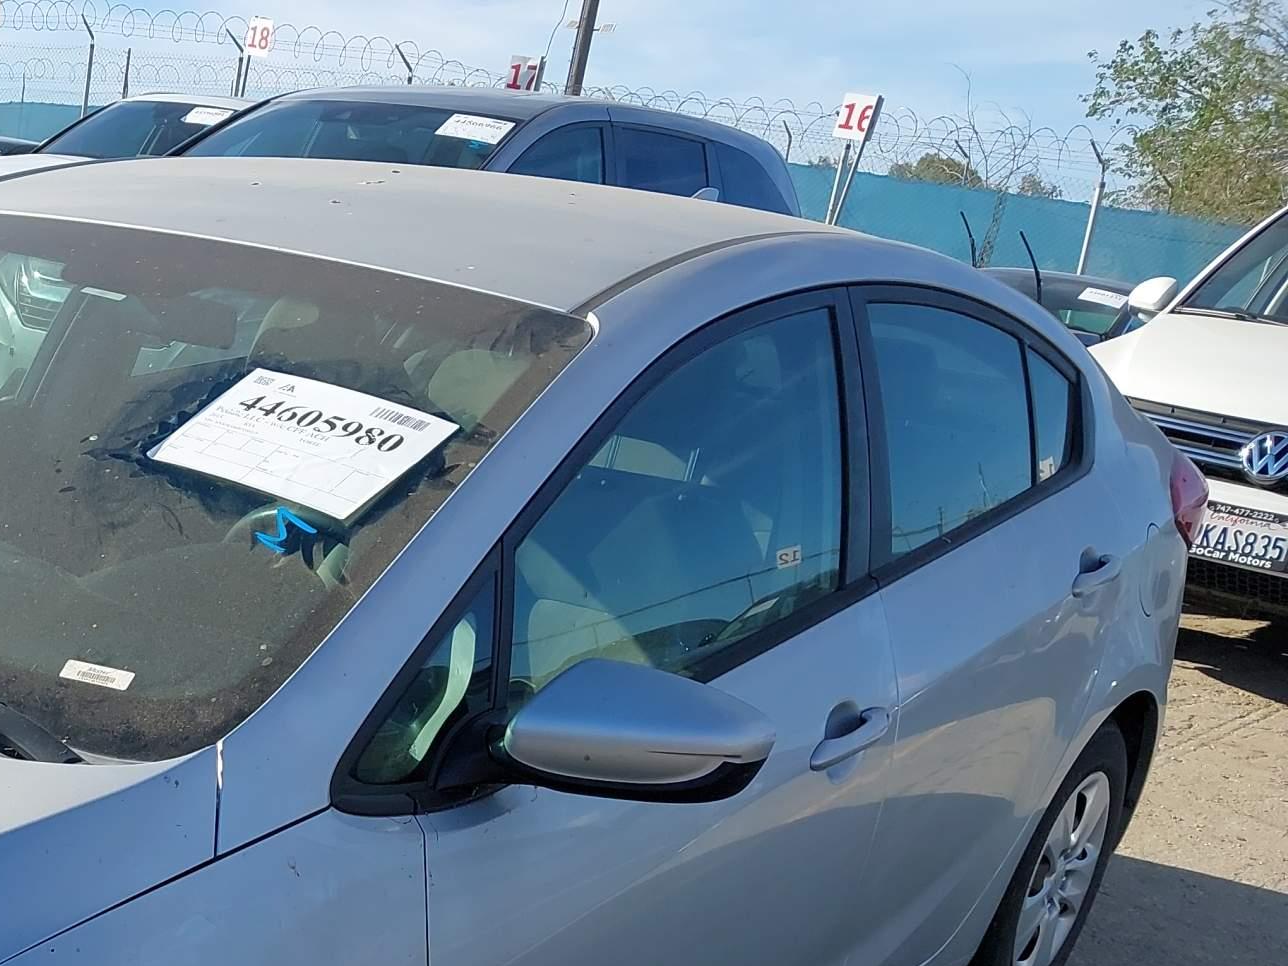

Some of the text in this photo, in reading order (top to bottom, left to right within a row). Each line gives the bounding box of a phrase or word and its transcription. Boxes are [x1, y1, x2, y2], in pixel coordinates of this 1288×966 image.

[247, 25, 270, 50] 18
[506, 63, 538, 91] 17
[838, 102, 874, 133] 16
[238, 395, 405, 453] 44605980
[1215, 503, 1275, 521] 747-477-2222
[1198, 523, 1288, 562] KAS835
[1228, 552, 1273, 569] Motors
